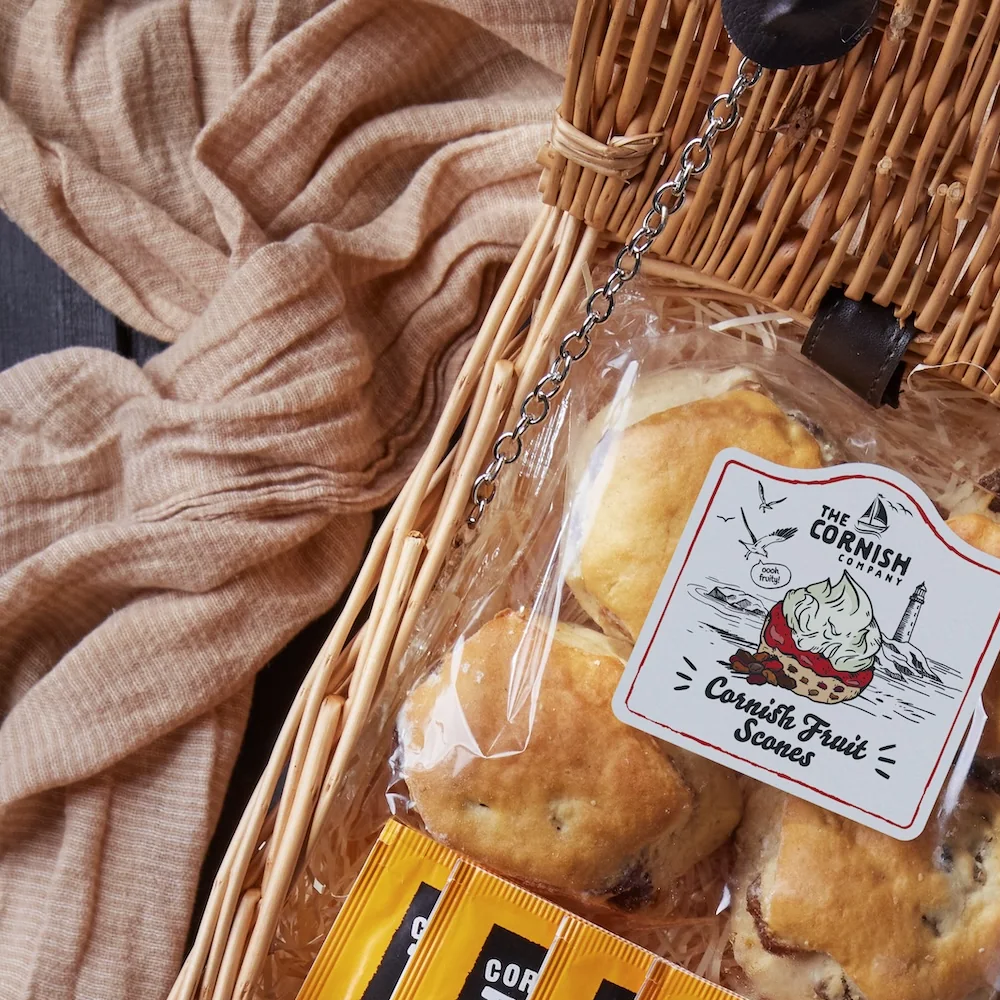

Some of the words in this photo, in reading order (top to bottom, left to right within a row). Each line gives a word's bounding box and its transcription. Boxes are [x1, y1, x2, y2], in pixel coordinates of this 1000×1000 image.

[820, 504, 850, 527] THE
[809, 519, 912, 576] CORNISH
[838, 554, 904, 586] COMPANY
[705, 676, 796, 731] Cornish
[797, 714, 867, 760] Fruit
[734, 718, 815, 767] Scones
